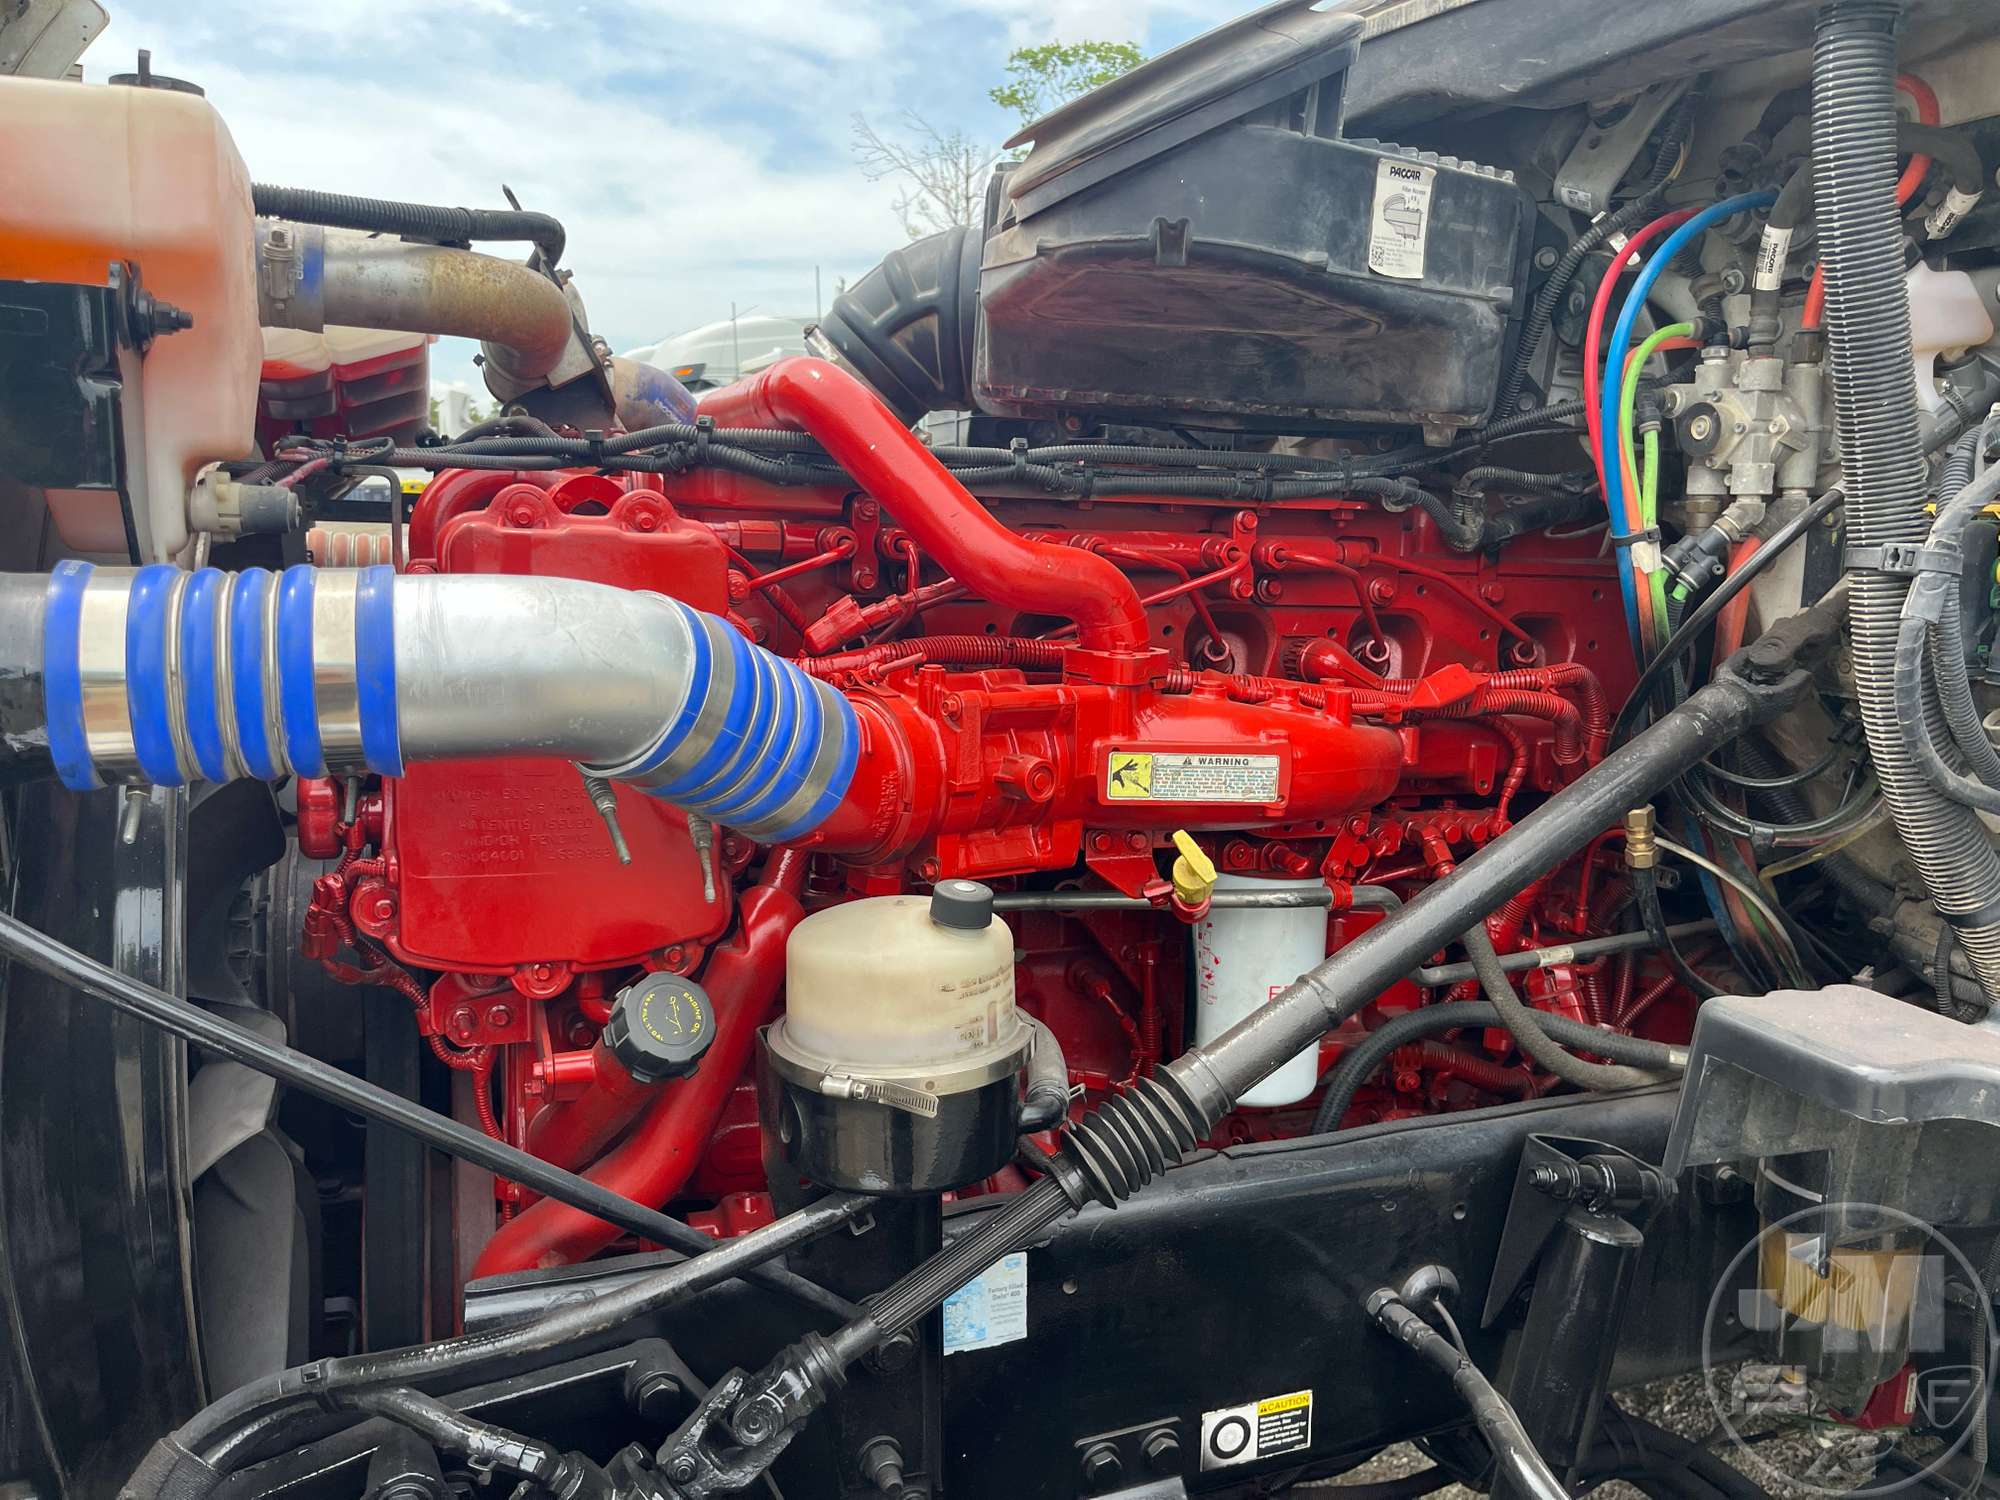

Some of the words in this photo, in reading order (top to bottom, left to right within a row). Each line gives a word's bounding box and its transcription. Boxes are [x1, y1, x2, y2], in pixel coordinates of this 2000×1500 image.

[1389, 166, 1422, 181] PACCAR
[1768, 243, 1778, 274] PACCAR
[1198, 757, 1250, 766] WARNING
[683, 991, 702, 1021] ENGINE
[691, 1022, 700, 1034] OIL
[1267, 1396, 1309, 1410] CAUTION
